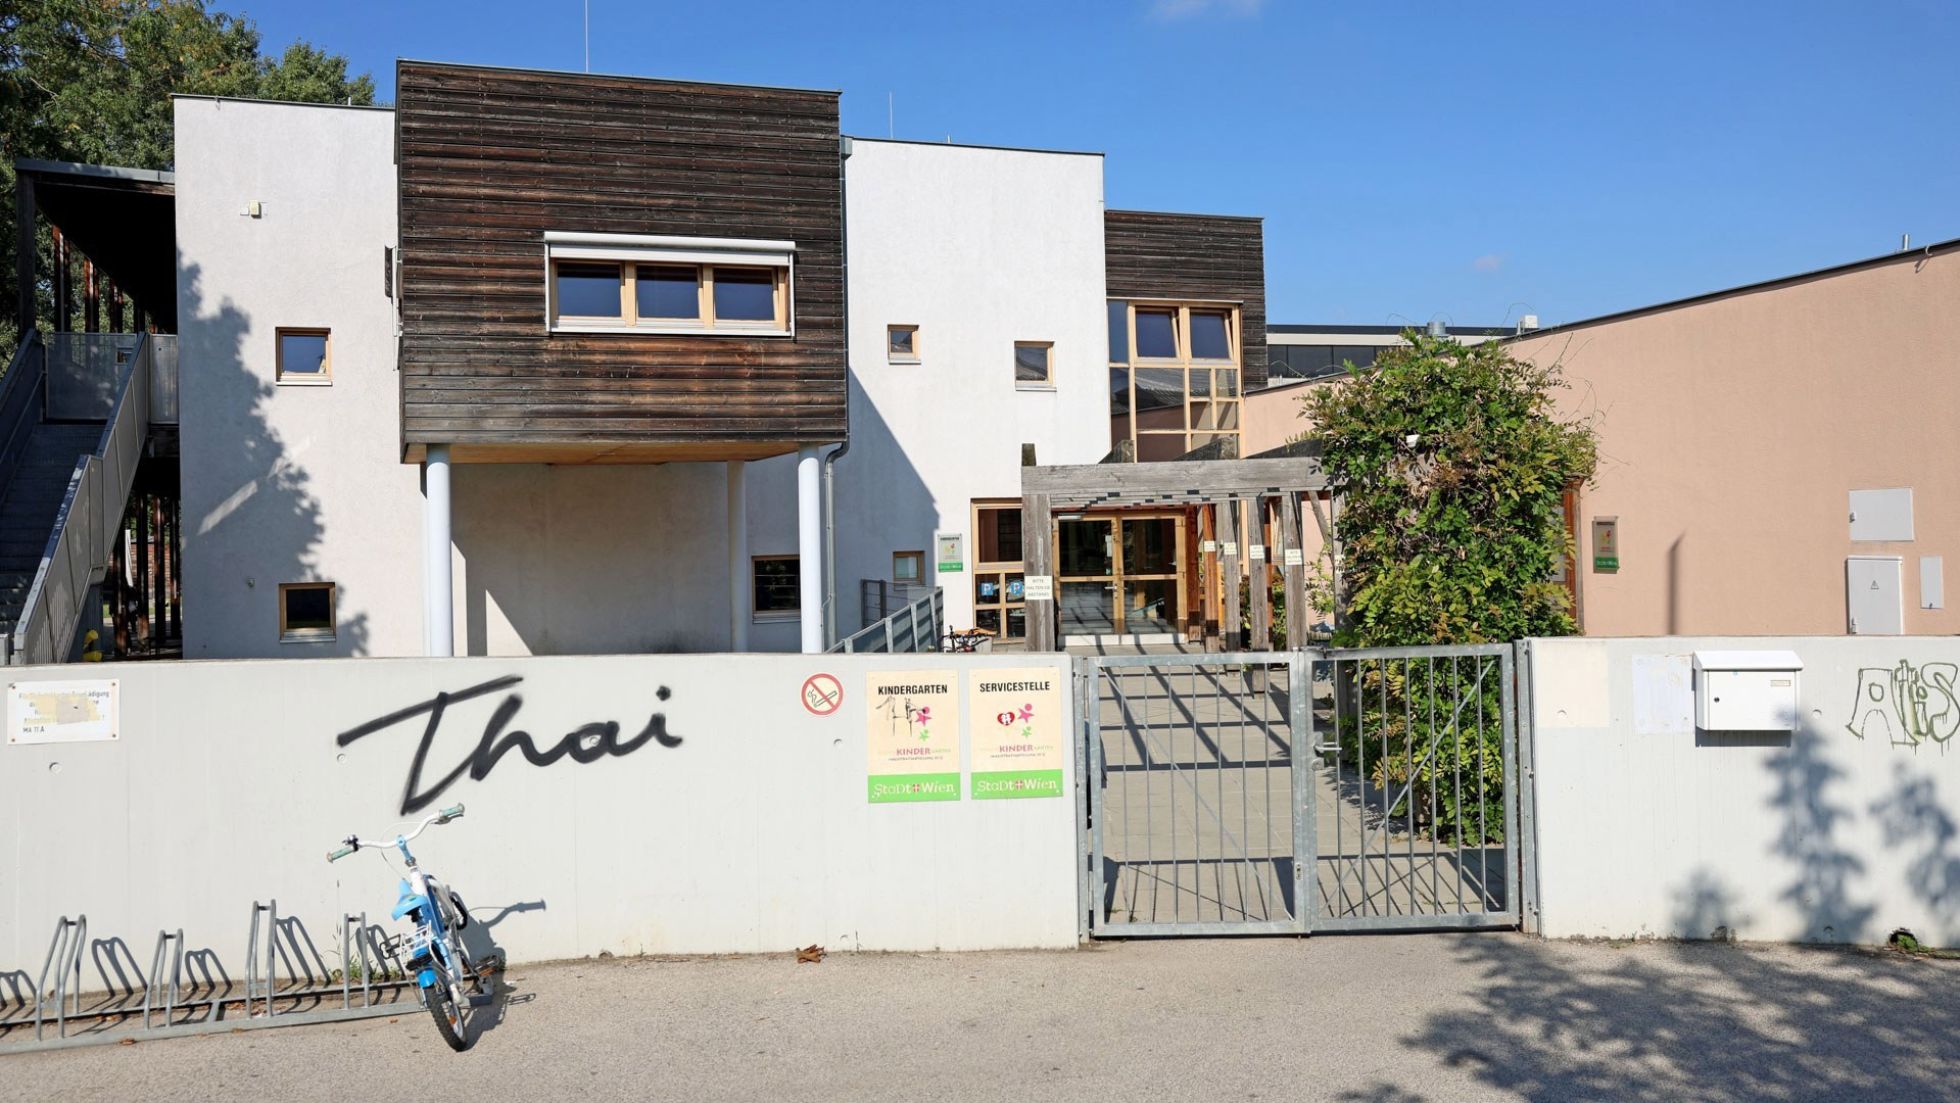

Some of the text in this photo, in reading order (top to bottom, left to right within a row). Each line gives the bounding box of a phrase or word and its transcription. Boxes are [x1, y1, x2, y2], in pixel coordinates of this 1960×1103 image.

[878, 684, 948, 695] KINDERGARTEN
[979, 681, 1051, 693] SERVICESTELLE
[337, 674, 683, 816] Thai
